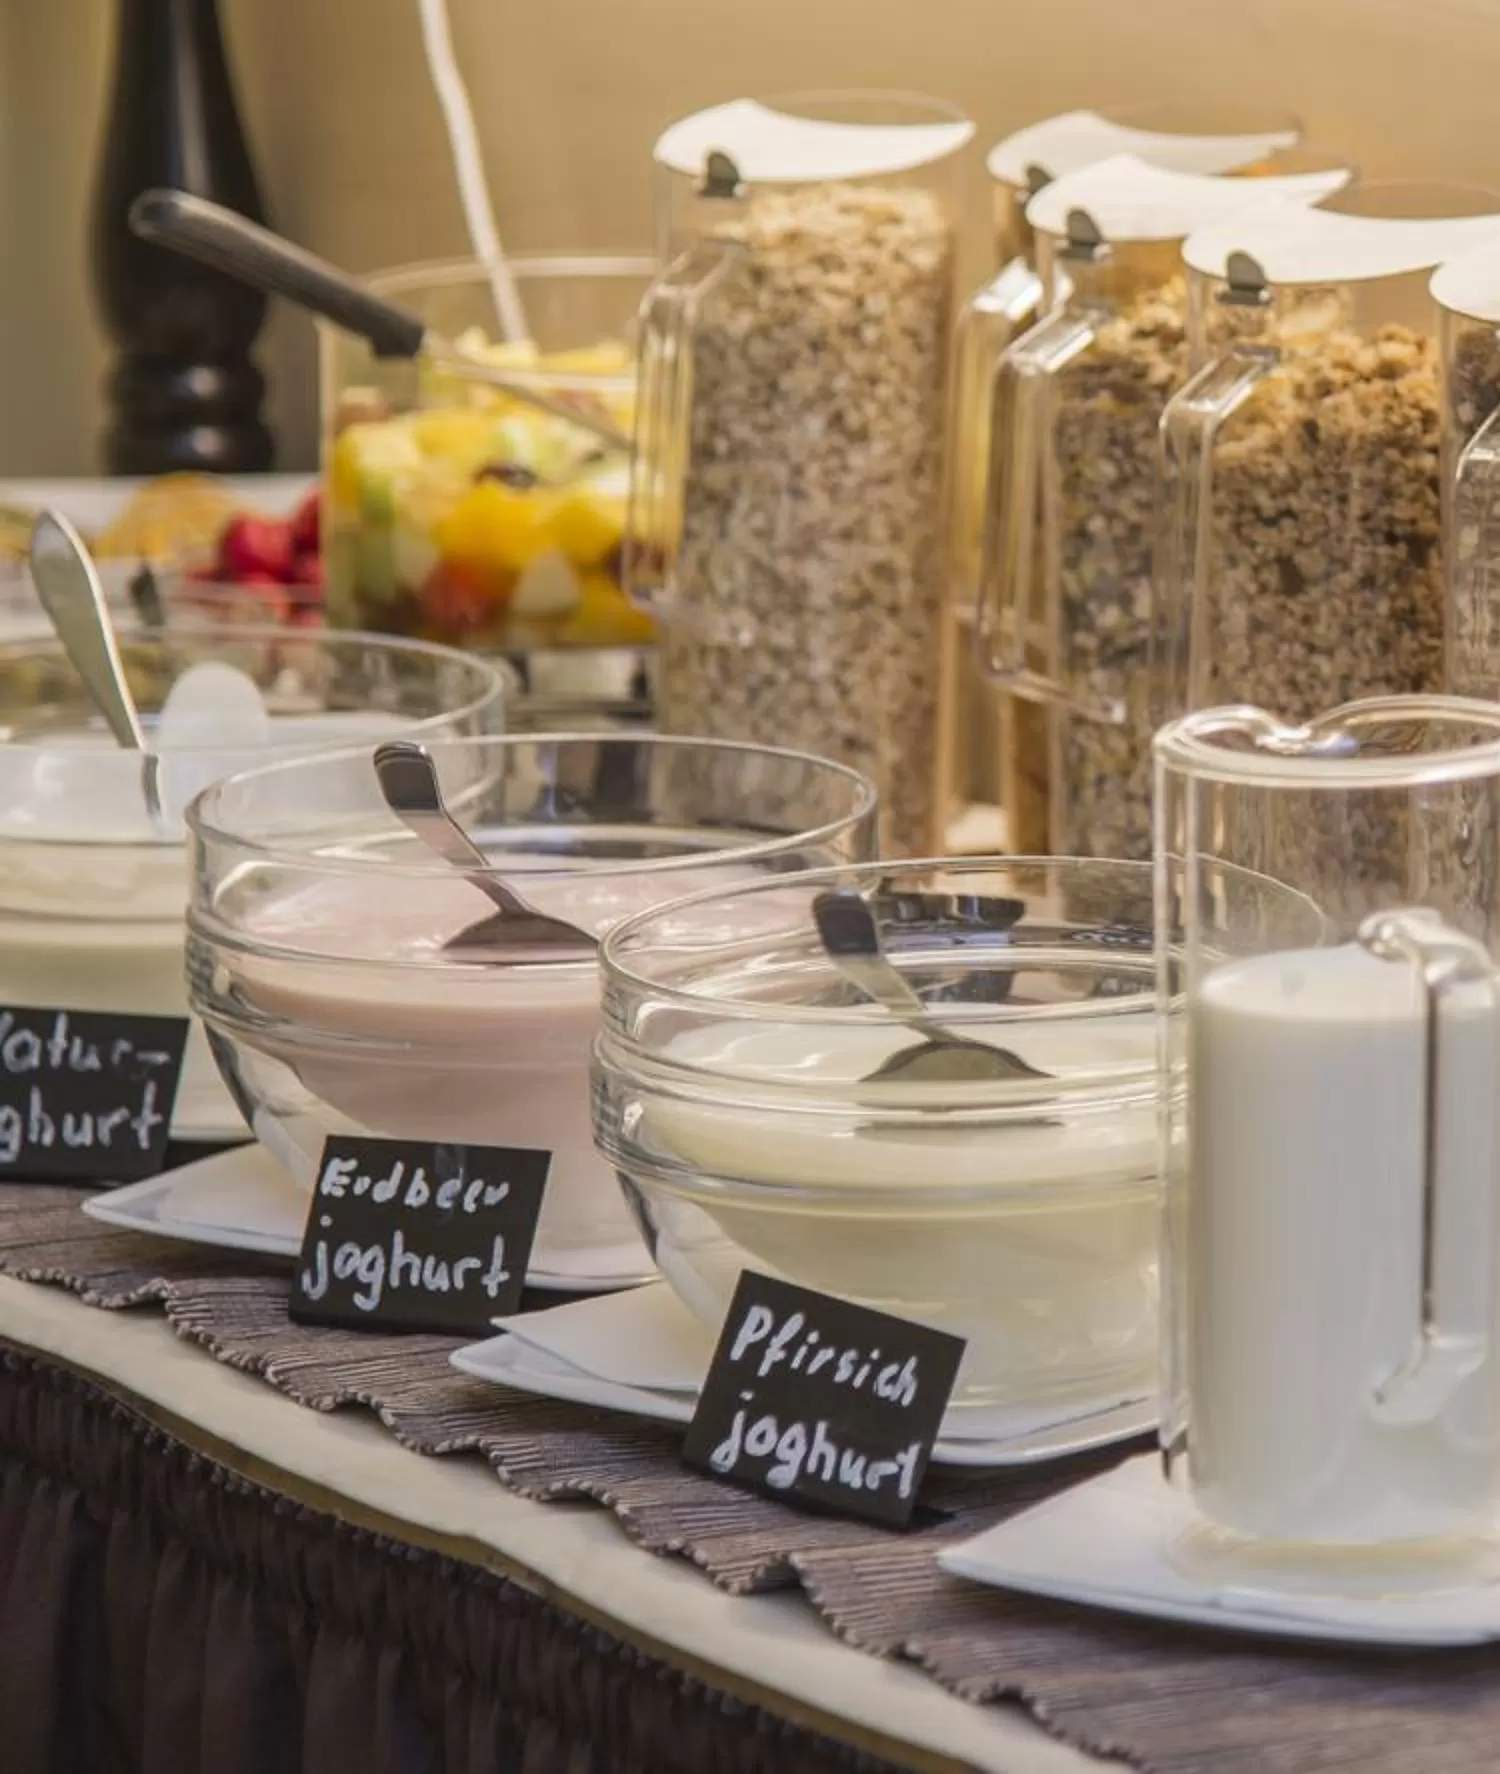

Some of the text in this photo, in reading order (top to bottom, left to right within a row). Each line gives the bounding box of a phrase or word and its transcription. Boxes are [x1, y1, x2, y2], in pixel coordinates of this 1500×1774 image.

[302, 1214, 510, 1312] joghurt
[729, 1304, 919, 1407] Pfirsich
[709, 1390, 923, 1499] joghurt
